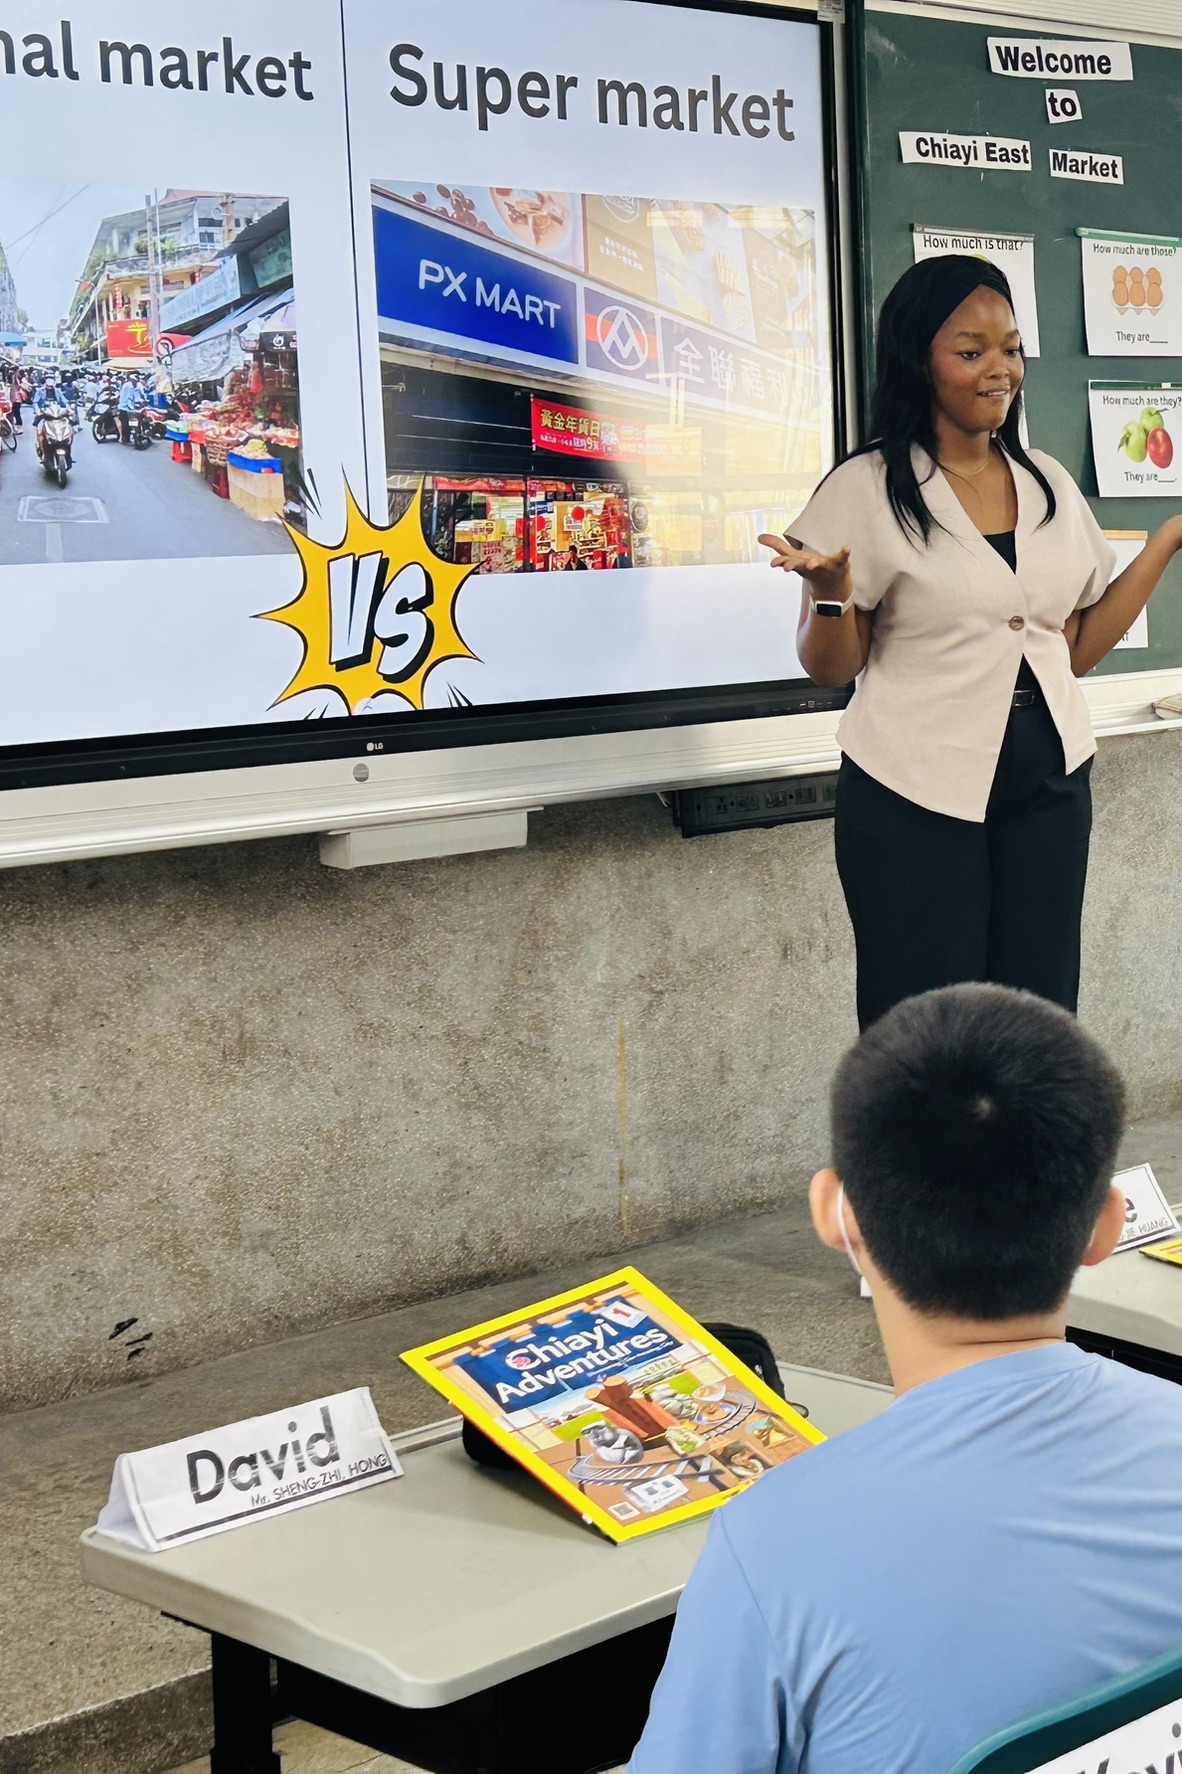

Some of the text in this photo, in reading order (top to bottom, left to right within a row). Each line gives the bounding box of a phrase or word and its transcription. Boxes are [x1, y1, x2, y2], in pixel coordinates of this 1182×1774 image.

[99, 36, 314, 101] market
[995, 45, 1112, 75] Welcome
[389, 43, 796, 141] Super market
[1048, 91, 1077, 117] to
[915, 136, 1030, 166] Chiayi East
[1052, 151, 1118, 179] Market
[923, 234, 949, 248] How
[951, 237, 982, 250] much
[985, 239, 994, 250] is
[1093, 243, 1177, 257] How much are those?
[418, 258, 561, 329] PX MART
[1116, 330, 1136, 344] They
[1102, 395, 1182, 409] How much are they?
[1124, 471, 1144, 484] They
[327, 550, 435, 684] VS
[613, 1308, 632, 1318] 1
[505, 1319, 619, 1371] Chiayi
[495, 1328, 668, 1404] Adventures
[186, 1405, 341, 1505] David
[348, 1453, 389, 1476] HONG
